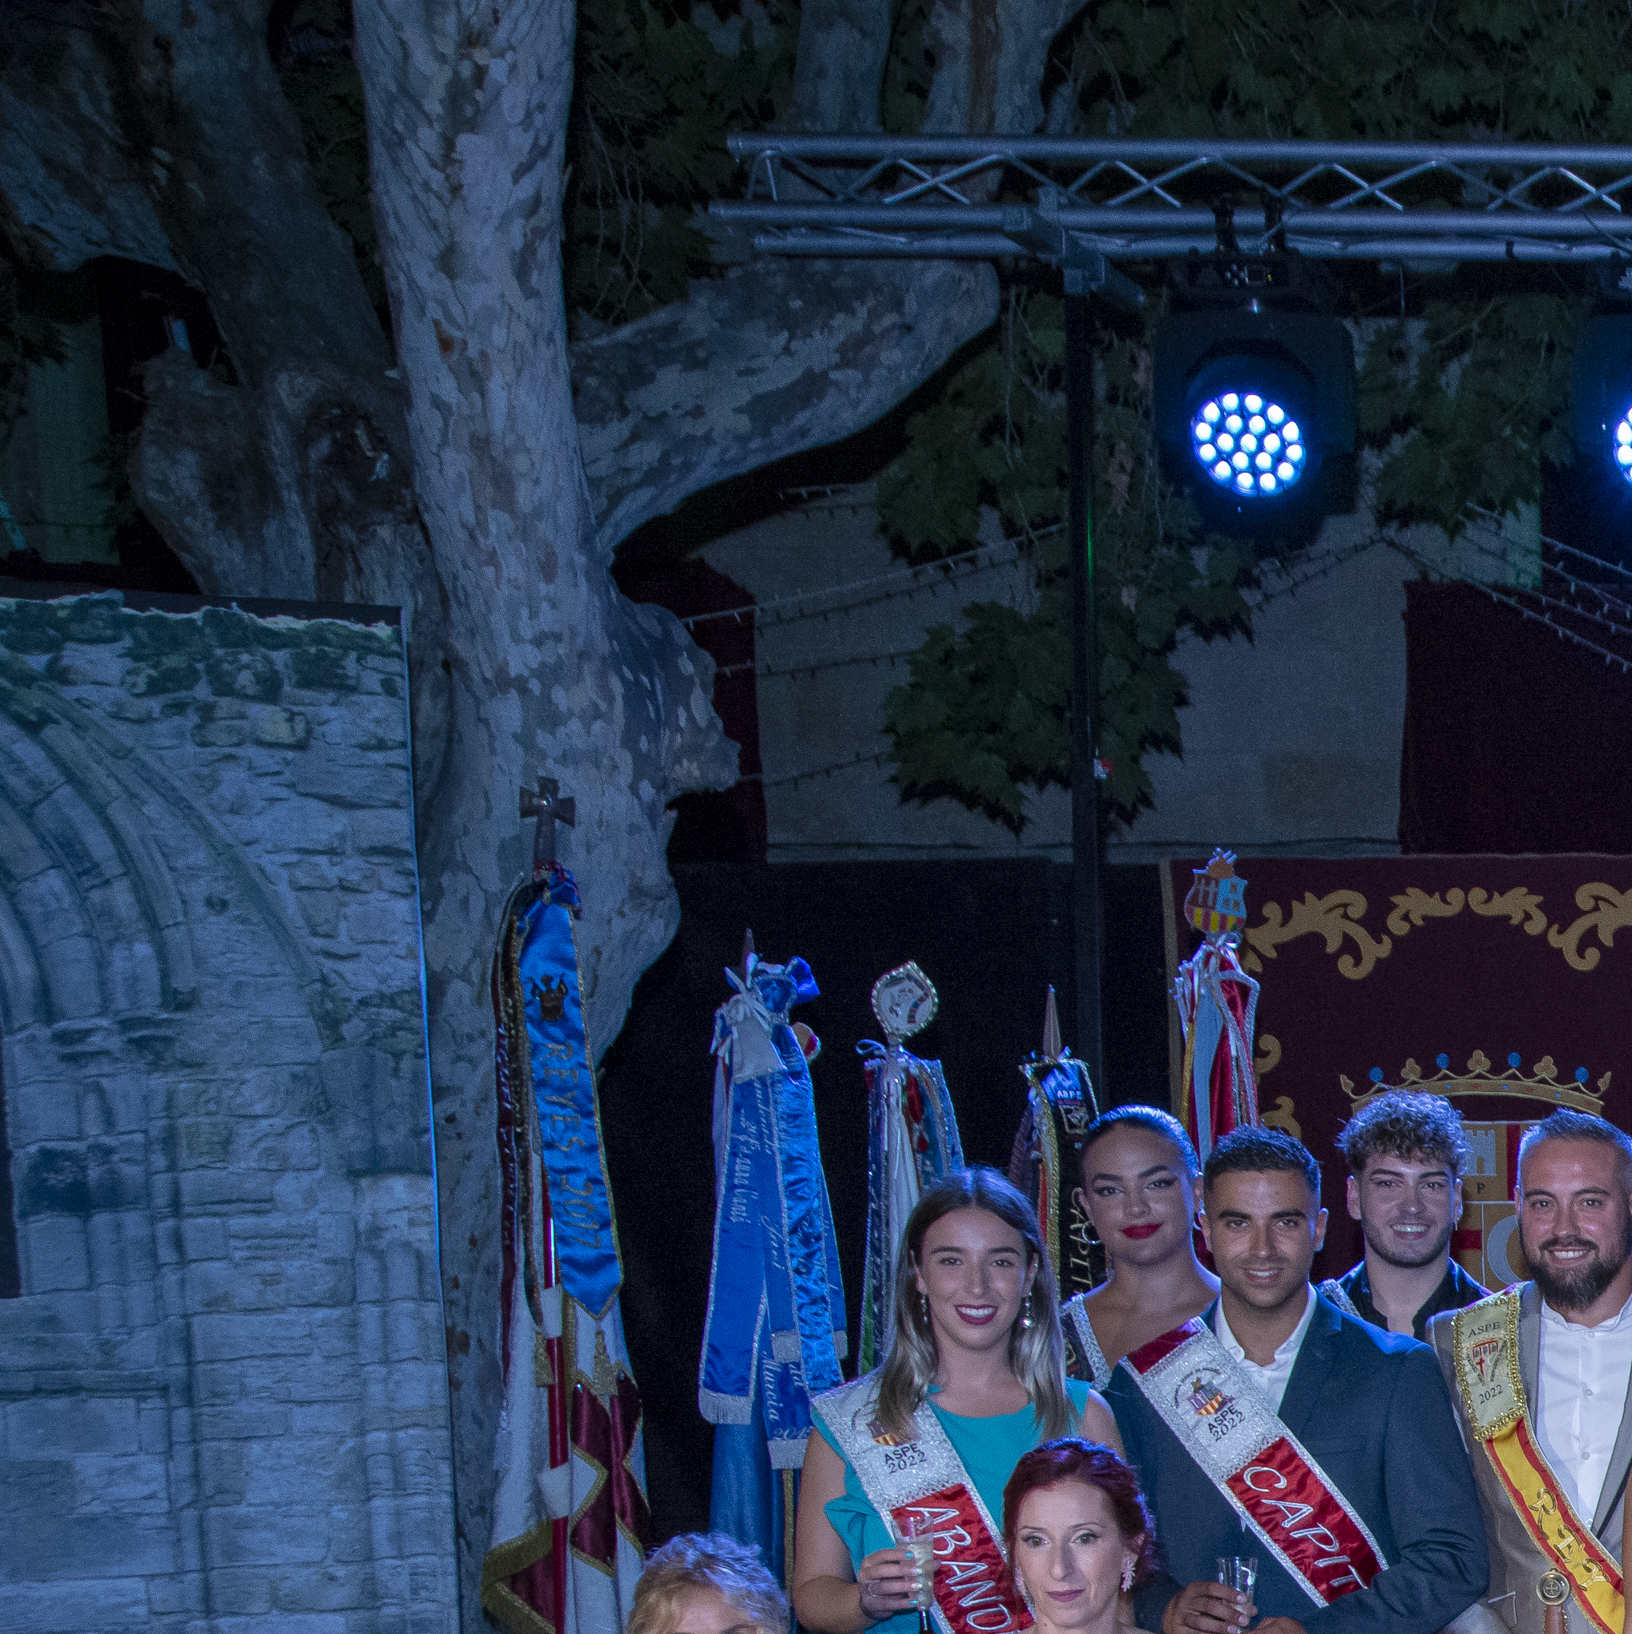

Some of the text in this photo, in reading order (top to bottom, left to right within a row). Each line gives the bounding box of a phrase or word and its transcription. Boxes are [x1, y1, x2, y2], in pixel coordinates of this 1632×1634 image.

[540, 1042, 600, 1250] REYES 2017
[1069, 1187, 1093, 1294] CAPIT
[1468, 1321, 1501, 1338] ASPE
[761, 1350, 784, 1422] Murcia
[1479, 1384, 1504, 1405] 2022
[1207, 1404, 1239, 1433] ASPE
[1213, 1411, 1247, 1442] 2022
[884, 1442, 919, 1464] ASPE
[888, 1452, 927, 1475] 2022
